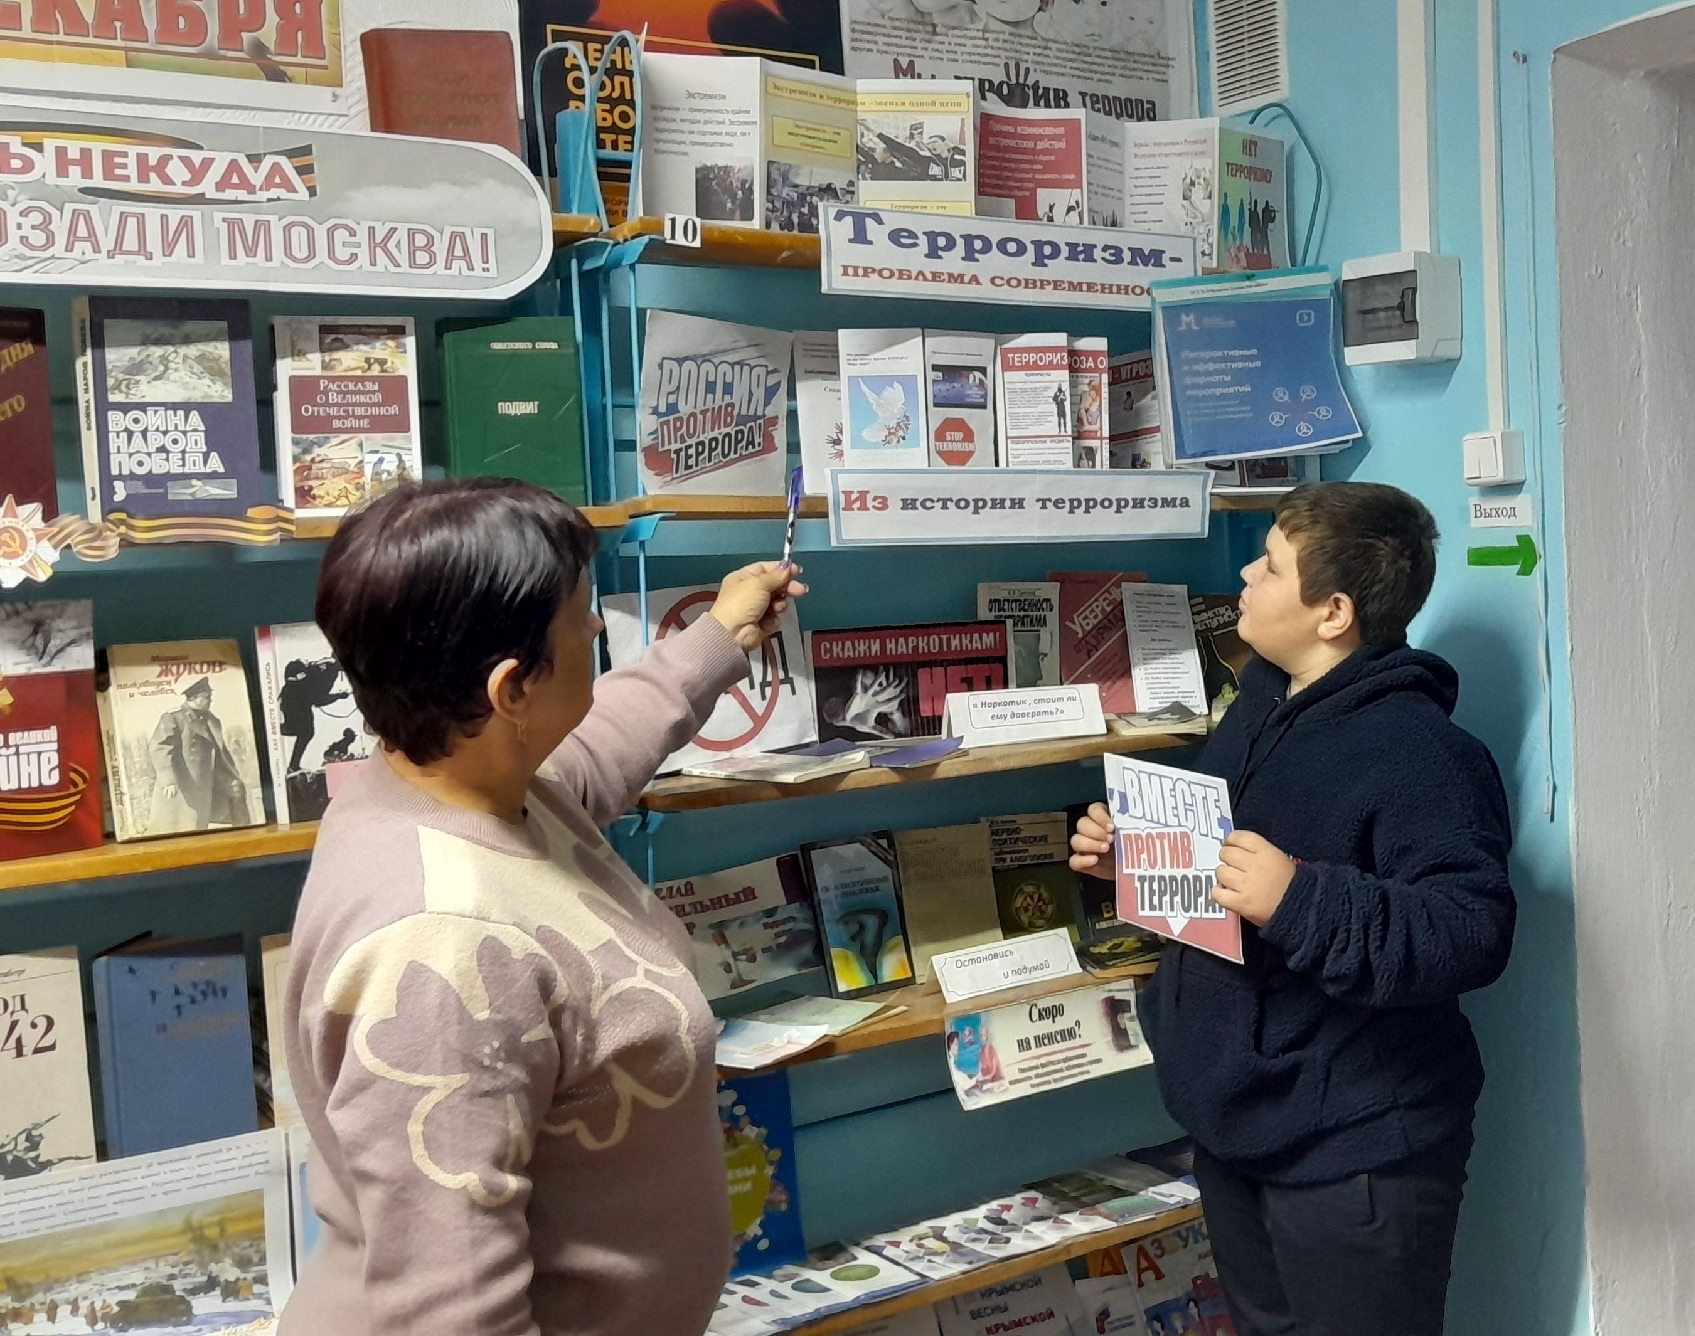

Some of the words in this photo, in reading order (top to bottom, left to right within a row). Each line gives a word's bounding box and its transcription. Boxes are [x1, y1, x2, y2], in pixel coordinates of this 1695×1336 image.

[685, 90, 727, 101] Экстремизм
[1242, 138, 1258, 158] НЕТ
[54, 145, 300, 195] НЕКУДА
[1225, 162, 1273, 184] ТЕРРОРИЗМУ
[0, 205, 196, 260] ЗАДИ
[222, 216, 491, 273] МОСКВА!
[667, 216, 698, 244] 10
[841, 264, 983, 286] ПРОБЛЕМА
[990, 275, 1151, 297] СОВРЕМЕННО
[1007, 352, 1068, 366] ТЕРРОРИЗ
[1069, 355, 1095, 369] ОЗА
[657, 356, 769, 417] РОССИЯ
[106, 406, 206, 432] ВОЙНА
[497, 401, 540, 416] ПОДВИГ
[658, 402, 736, 449] ПРОТИВ
[945, 431, 964, 441] STOP
[108, 431, 207, 453] НАРОД
[672, 424, 764, 476] ТЕРРОРА!
[934, 441, 977, 452] TERRORISM
[109, 452, 226, 475] ПОБЕДА
[840, 490, 889, 512] Из
[899, 496, 1026, 515] истории
[1035, 493, 1191, 514] терроризма
[1472, 503, 1518, 520] Выход
[987, 598, 1055, 614] ОТВЕТСТВЕННОСТЬ
[819, 637, 881, 660] СКАЖИ
[886, 631, 1000, 656] НАРКОТИКАМ!
[266, 661, 275, 706] СРАЖАЛИСЬ
[1033, 697, 1065, 705] стоит
[269, 707, 279, 737] ВМЕСТЕ
[990, 713, 1008, 722] ему
[1009, 707, 1065, 720] доверять?»
[1122, 766, 1225, 840] ВМЕСТЕ
[1122, 832, 1194, 870] ПРОТИВ
[955, 949, 1015, 969] Остановись
[1002, 971, 1009, 979] и
[1010, 959, 1051, 978] подумай
[1028, 1002, 1066, 1024] Скоро
[1016, 1037, 1033, 1053] на
[1033, 1019, 1082, 1050] пенсию?
[980, 1275, 1043, 1299] КРЫМСКОЙ
[968, 1302, 1009, 1321] ВЕСНЫ
[985, 1307, 1056, 1336] КРЫМСКОЙ
